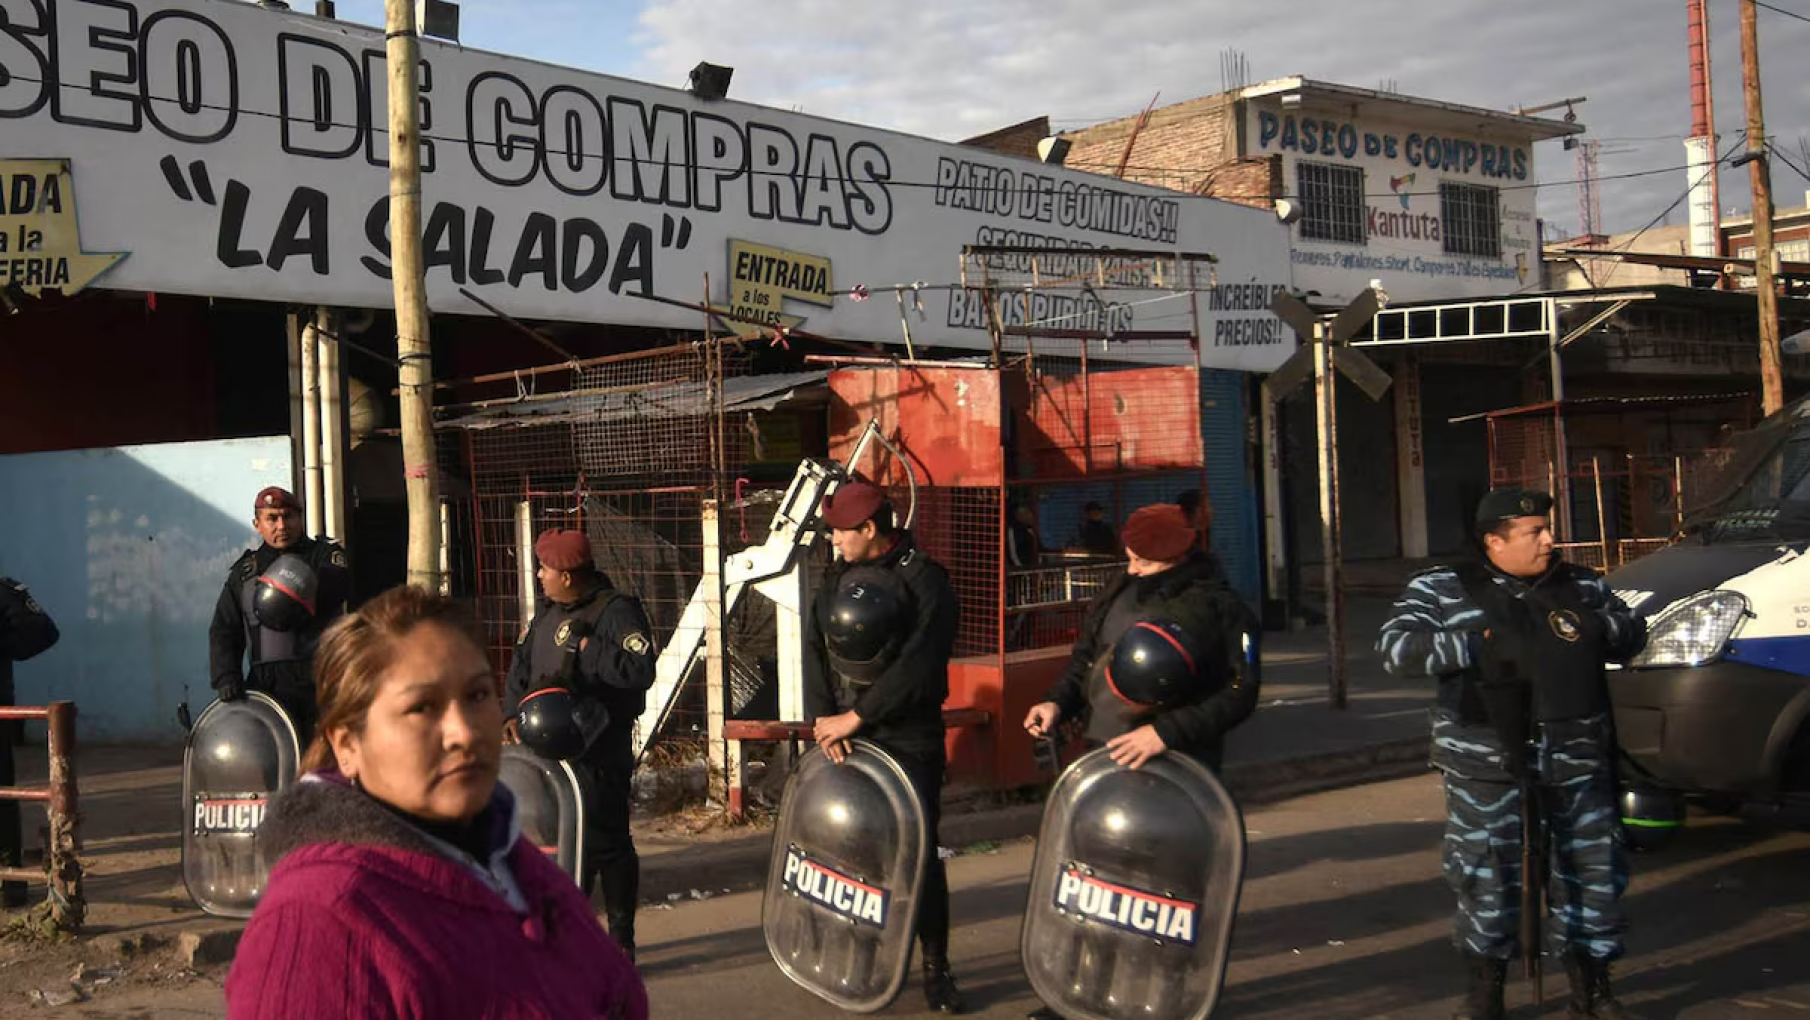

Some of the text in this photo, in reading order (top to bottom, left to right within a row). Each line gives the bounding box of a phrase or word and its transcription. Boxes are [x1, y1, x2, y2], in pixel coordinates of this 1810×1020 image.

[278, 32, 436, 173] DE
[466, 71, 893, 235] COMPRAS
[1259, 110, 1527, 181] PASEO DE COMPRAS
[0, 173, 62, 216] DA
[935, 157, 1180, 244] PATIO DE COMIDAS!!
[18, 224, 43, 253] la
[1367, 205, 1441, 242] Kantuta
[735, 251, 828, 296] ENTRADA
[1209, 276, 1286, 311] INCREÍBL
[729, 305, 782, 325] LOCALES
[742, 288, 770, 306] a los
[948, 284, 1025, 330] BAOS
[1214, 318, 1283, 347] PRECIOS!!
[783, 851, 884, 925] POLICIA
[1058, 872, 1197, 942] POLICIA
